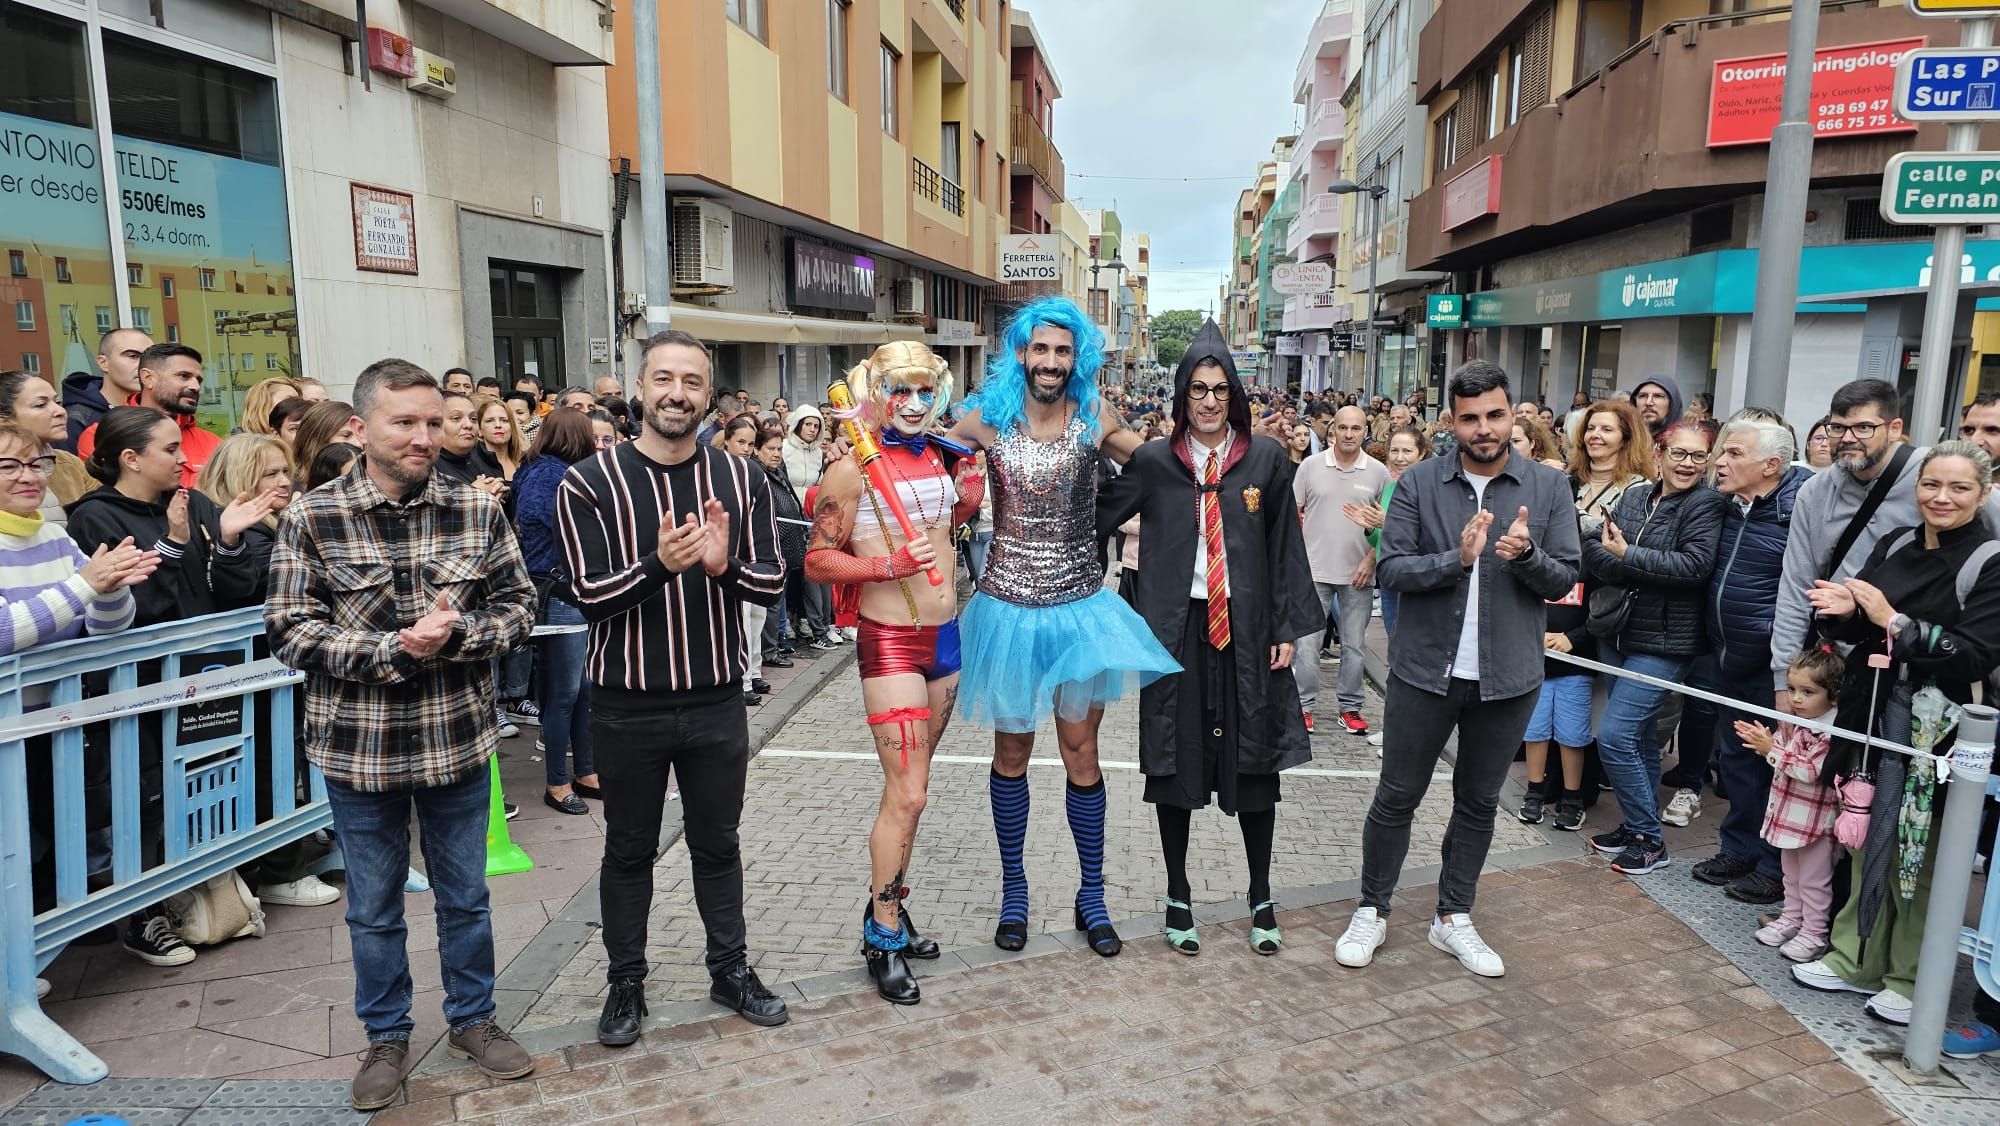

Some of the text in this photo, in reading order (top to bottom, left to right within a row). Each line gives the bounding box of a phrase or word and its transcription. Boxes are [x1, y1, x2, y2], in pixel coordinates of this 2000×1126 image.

[1918, 59, 1967, 79] Las
[1832, 86, 1872, 97] Cuerdas
[1913, 86, 1962, 107] Sur
[1818, 99, 1889, 116] 928 69 47
[1817, 118, 1843, 131] 666
[1847, 116, 1865, 128] 75
[1869, 114, 1887, 126] 75
[116, 150, 180, 184] TELDE
[1909, 165, 1968, 182] calle
[31, 174, 99, 204] desde
[122, 189, 206, 219] 550€/mes
[374, 216, 397, 230] POETA
[168, 227, 211, 248] dorm.
[367, 230, 406, 245] FERNANDO
[797, 253, 875, 300] MANHATTAN
[1637, 273, 1679, 307] cajamar
[1545, 289, 1572, 314] cajamar
[1429, 313, 1460, 322] cajamar
